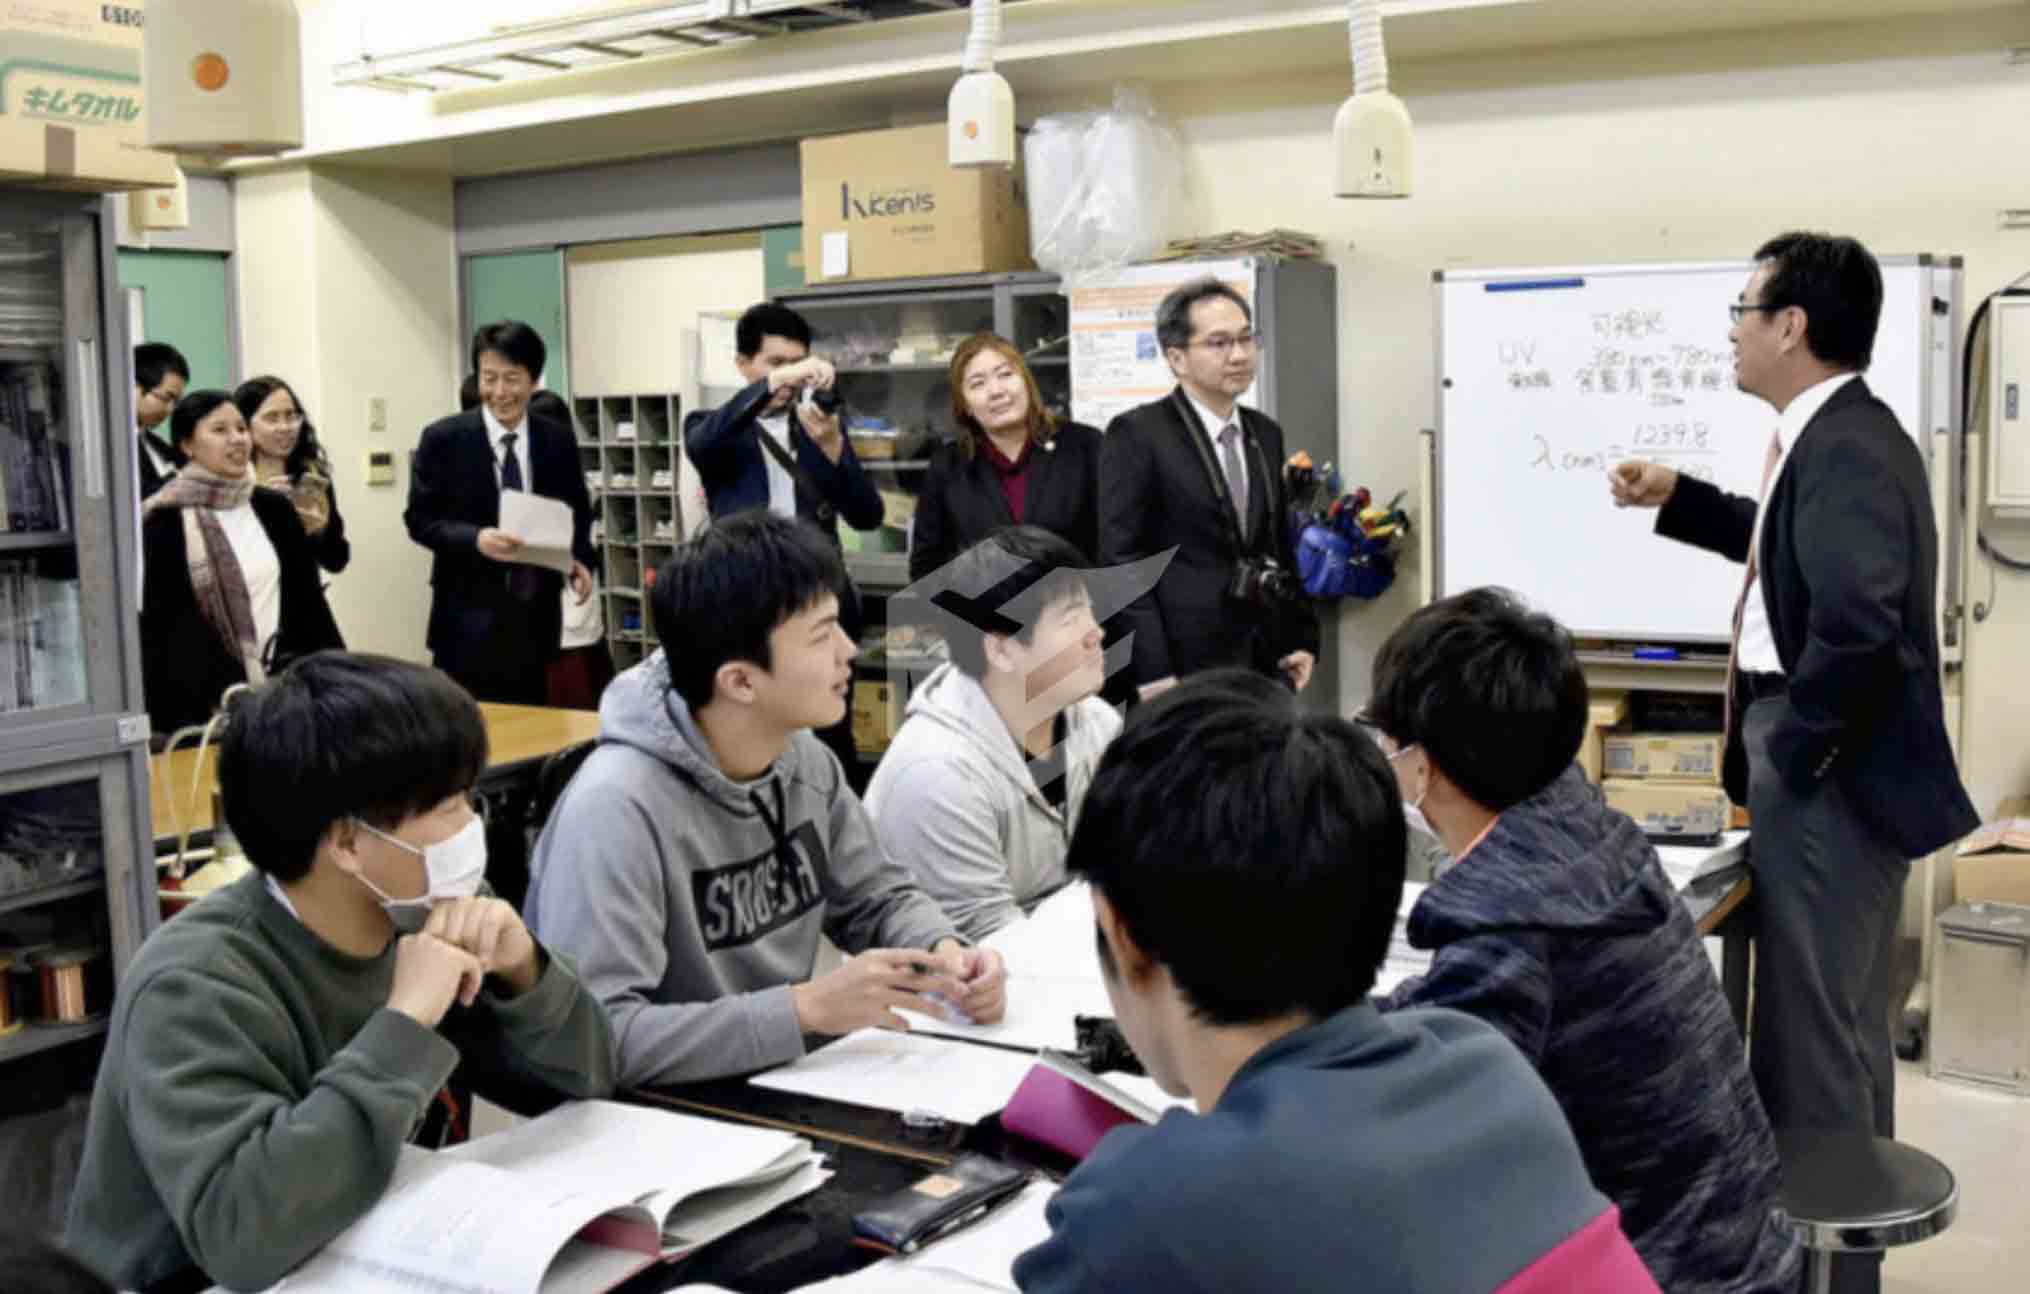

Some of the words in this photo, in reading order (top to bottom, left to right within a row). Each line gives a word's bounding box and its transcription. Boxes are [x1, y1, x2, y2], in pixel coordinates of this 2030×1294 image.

[24, 86, 140, 121] キムタオル
